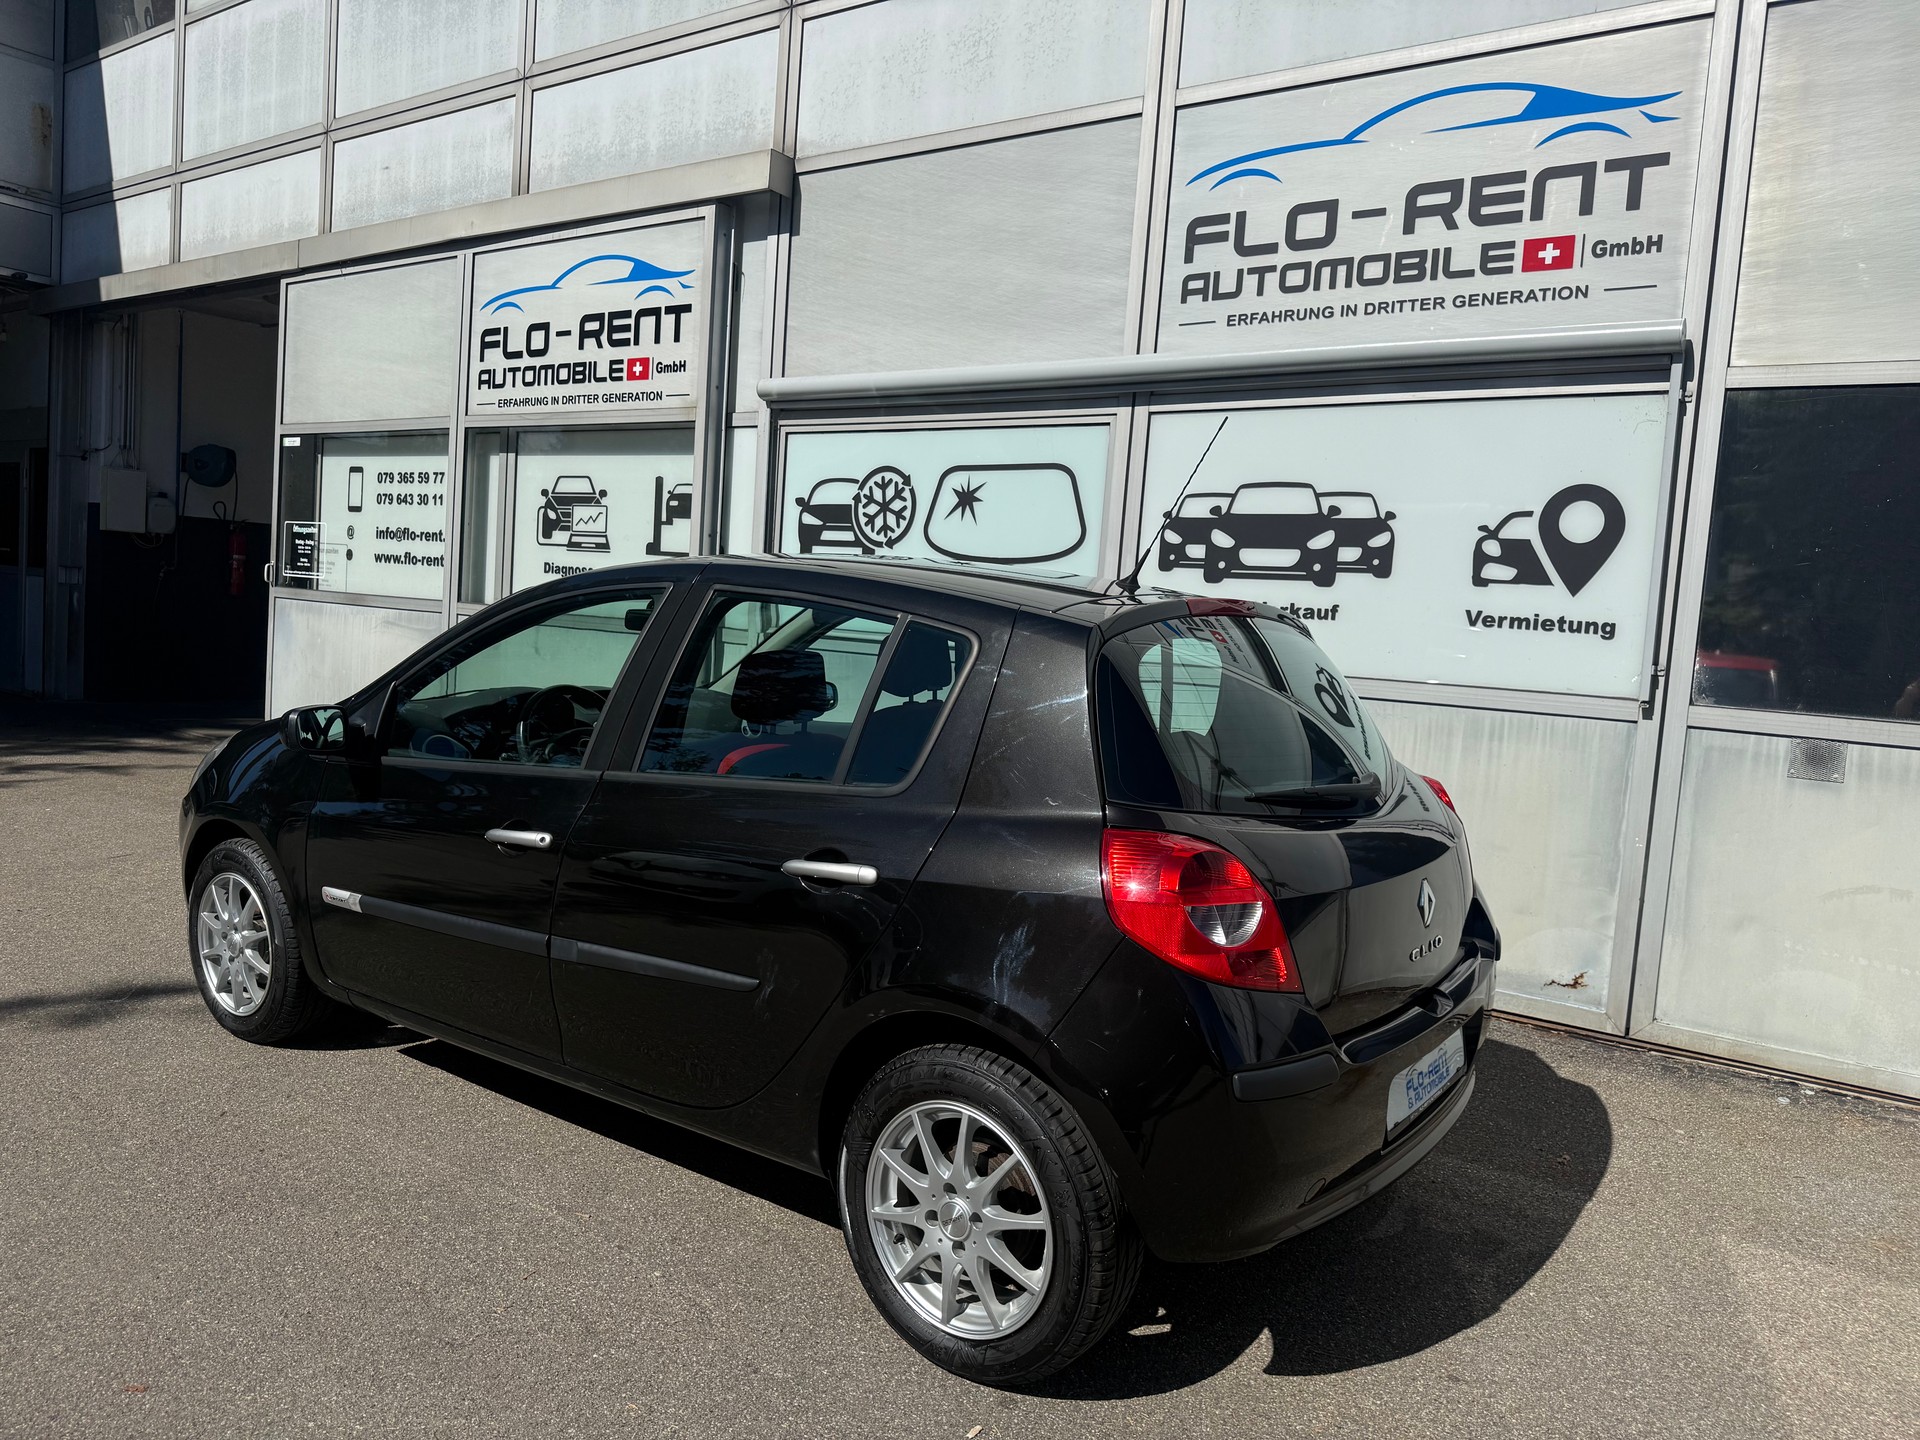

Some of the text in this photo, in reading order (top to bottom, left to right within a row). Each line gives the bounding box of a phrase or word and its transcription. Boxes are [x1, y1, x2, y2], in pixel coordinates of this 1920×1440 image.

[1184, 152, 1671, 264] FLO-RENT
[1180, 234, 1664, 305] AUTOMOBILE GmbH
[1226, 284, 1589, 327] ERFAHRUNG IN DRITTER GENERATION
[479, 304, 692, 363] FLO-RENT
[477, 358, 687, 391] AUTOMOBILE GmbH
[497, 390, 663, 408] ERFAHRUNG IN DRITTER GENERATION
[377, 472, 445, 484] 079 365 59 77
[376, 493, 444, 506] 079 643 30 11
[543, 561, 593, 578] Diagnos
[1465, 609, 1617, 641] Vermietung
[1409, 934, 1443, 962] CLIO
